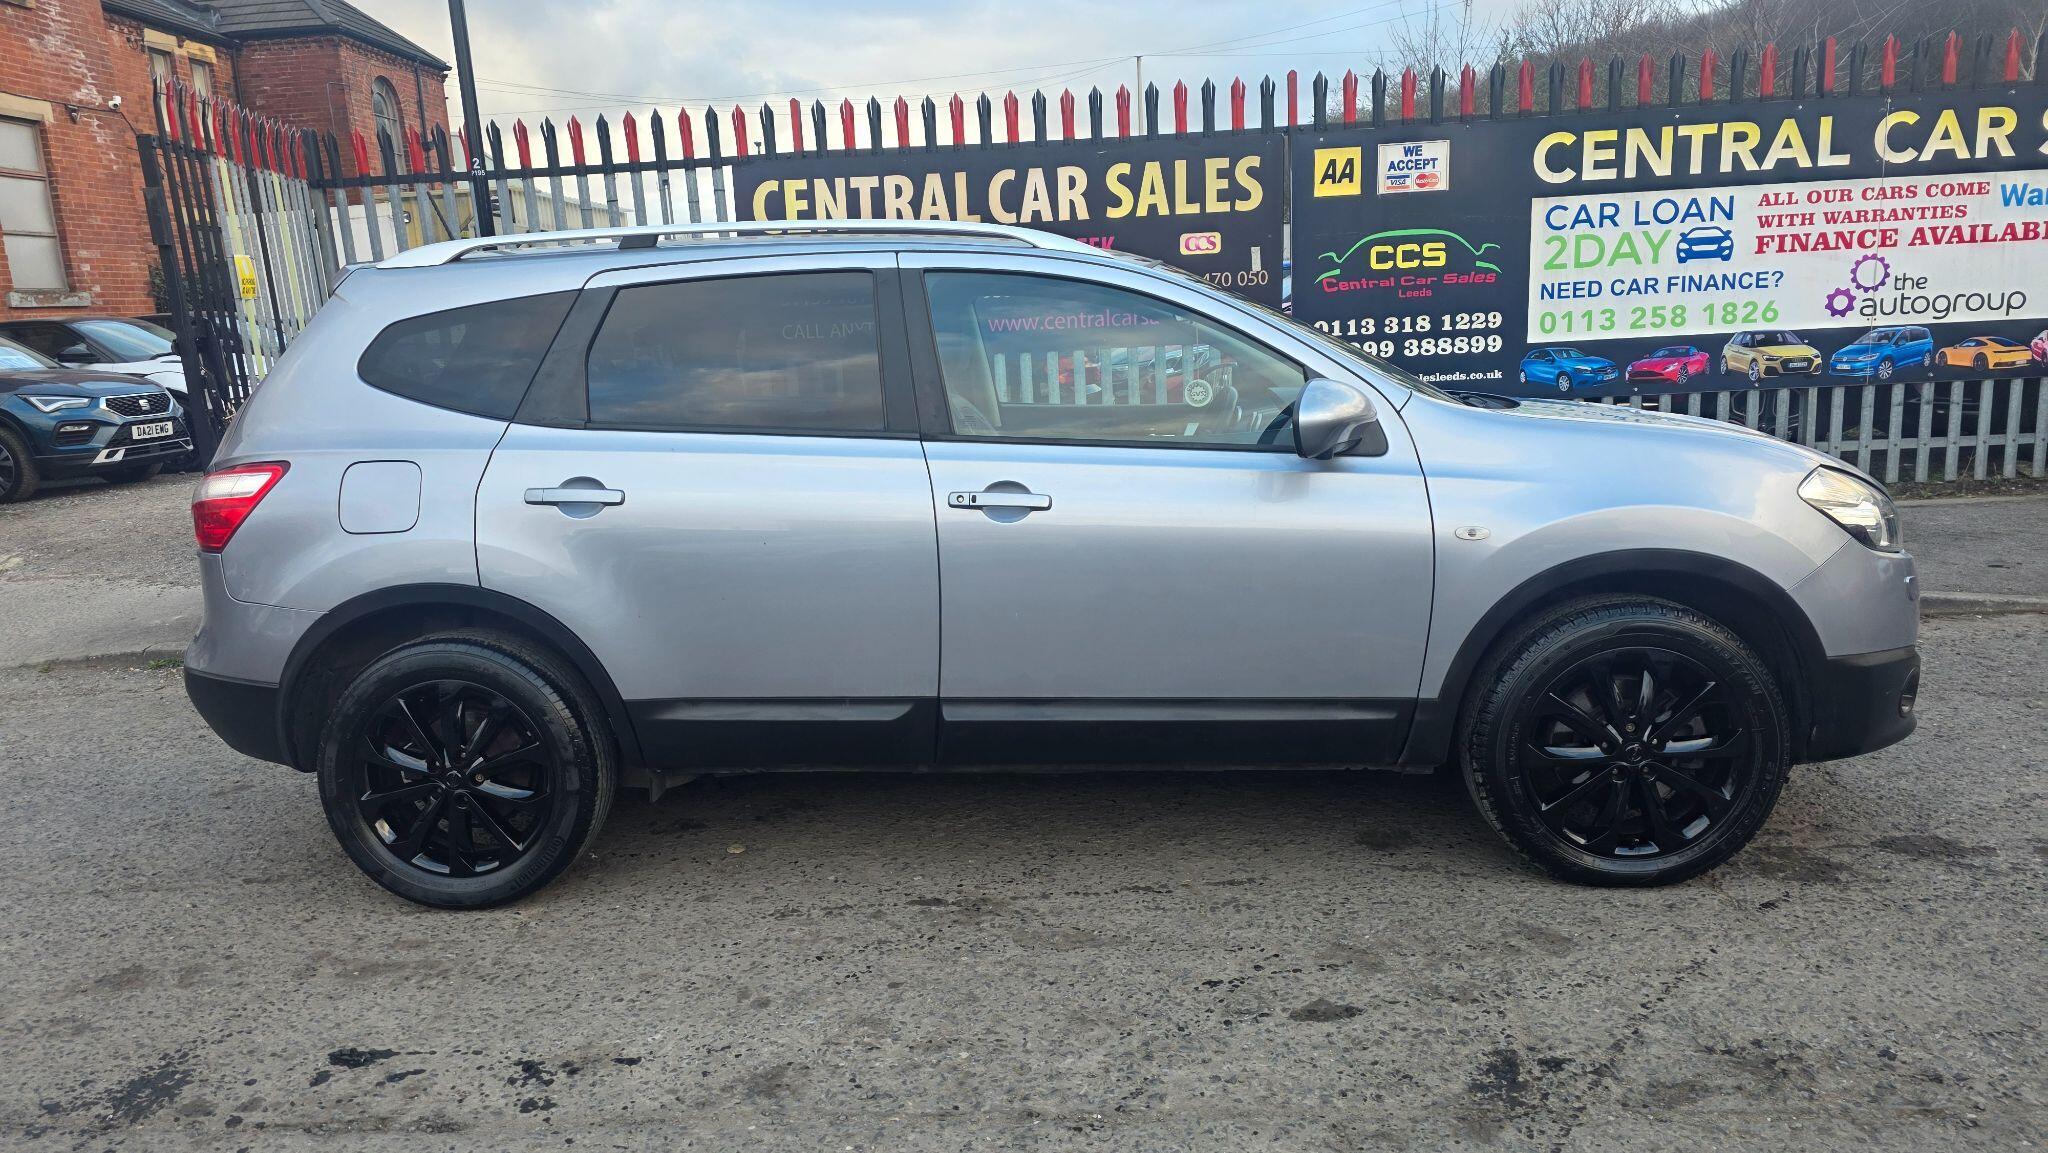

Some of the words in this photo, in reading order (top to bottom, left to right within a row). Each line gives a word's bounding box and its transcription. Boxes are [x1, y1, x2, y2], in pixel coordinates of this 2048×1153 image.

[1403, 145, 1423, 157] WE
[1533, 115, 1851, 184] CENTRAL
[1874, 106, 2018, 164] CAR
[472, 157, 481, 169] 2
[1320, 158, 1355, 184] AA
[1388, 158, 1438, 172] ACCEPT
[753, 171, 981, 232] CENTRAL
[988, 165, 1090, 224] CAR
[1106, 155, 1264, 219] SALES
[1757, 192, 1799, 207] ALL
[1806, 188, 1853, 204] OUR
[1861, 184, 1918, 201] CARS
[1925, 181, 1991, 197] COME
[1545, 202, 1620, 231] CAR
[1634, 195, 1735, 226] LOAN
[1757, 211, 1815, 229] WITH
[1823, 204, 1968, 225] WARRANTIES
[1755, 228, 1899, 255] FINANCE
[1908, 220, 2048, 247] AVAILAB
[1370, 242, 1447, 270] CCS
[1543, 229, 1672, 271] 2DAY
[1237, 270, 1268, 287] 050
[1322, 277, 1395, 293] Central
[1400, 276, 1437, 286] Car
[1443, 272, 1497, 284] Sales
[1540, 280, 1603, 300] NEED
[1610, 277, 1659, 296] CAR
[1666, 270, 1785, 294] FINANCE?
[1894, 273, 1928, 291] the
[1398, 288, 1433, 298] Leeds
[1860, 290, 2027, 320] autogroup
[1384, 315, 1431, 333] 318
[1441, 311, 1503, 331] 1229
[1539, 308, 1616, 334] 0113
[1629, 304, 1687, 329] 258
[1702, 300, 1779, 326] 1826
[782, 324, 825, 340] CALL
[1403, 335, 1503, 357] 388899
[1415, 369, 1503, 382] lesleeds.co.uk
[137, 426, 153, 436] DA21
